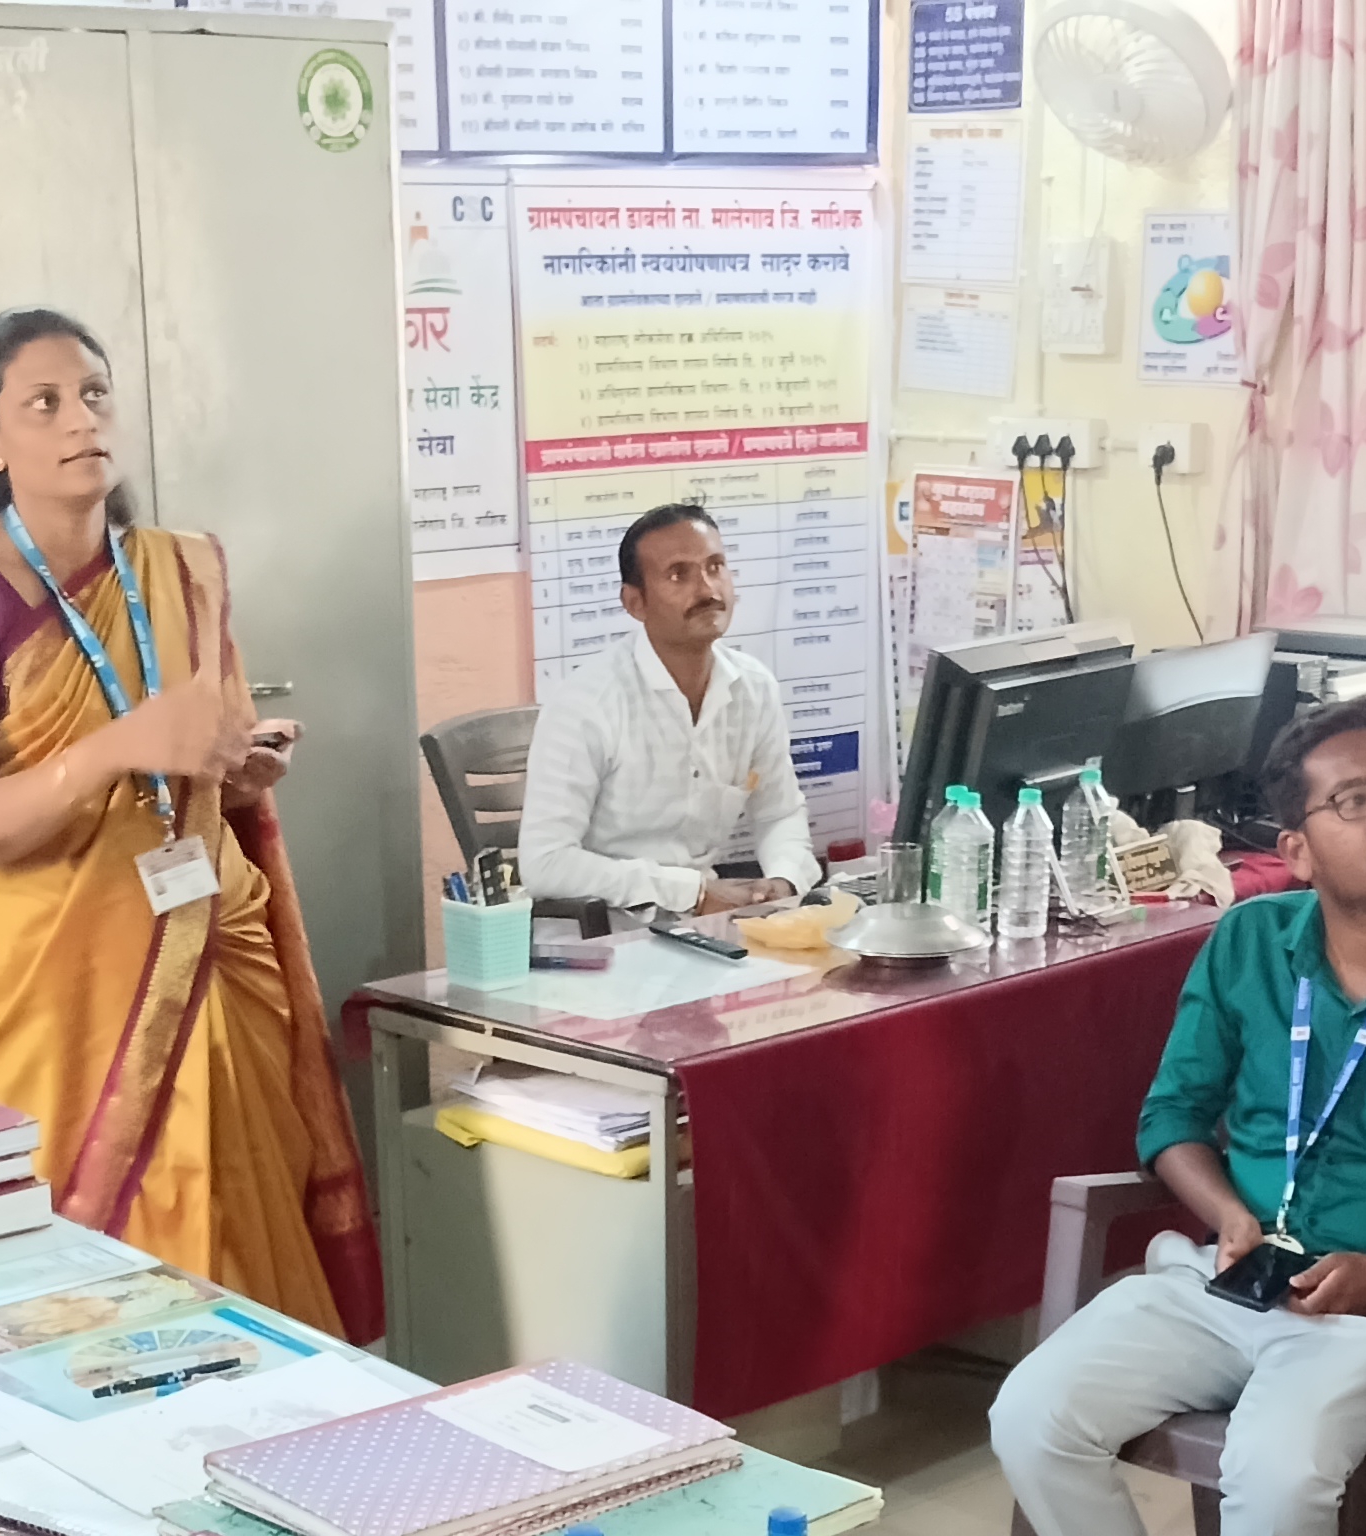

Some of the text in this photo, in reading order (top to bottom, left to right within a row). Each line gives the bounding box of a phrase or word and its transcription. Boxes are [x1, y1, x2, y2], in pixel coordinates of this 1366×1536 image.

[543, 246, 636, 275] नागरिकांनी
[761, 252, 802, 277] सादर
[807, 246, 851, 273] करावे
[424, 374, 500, 411] सेवा केंद्र
[417, 429, 455, 457] सेवा
